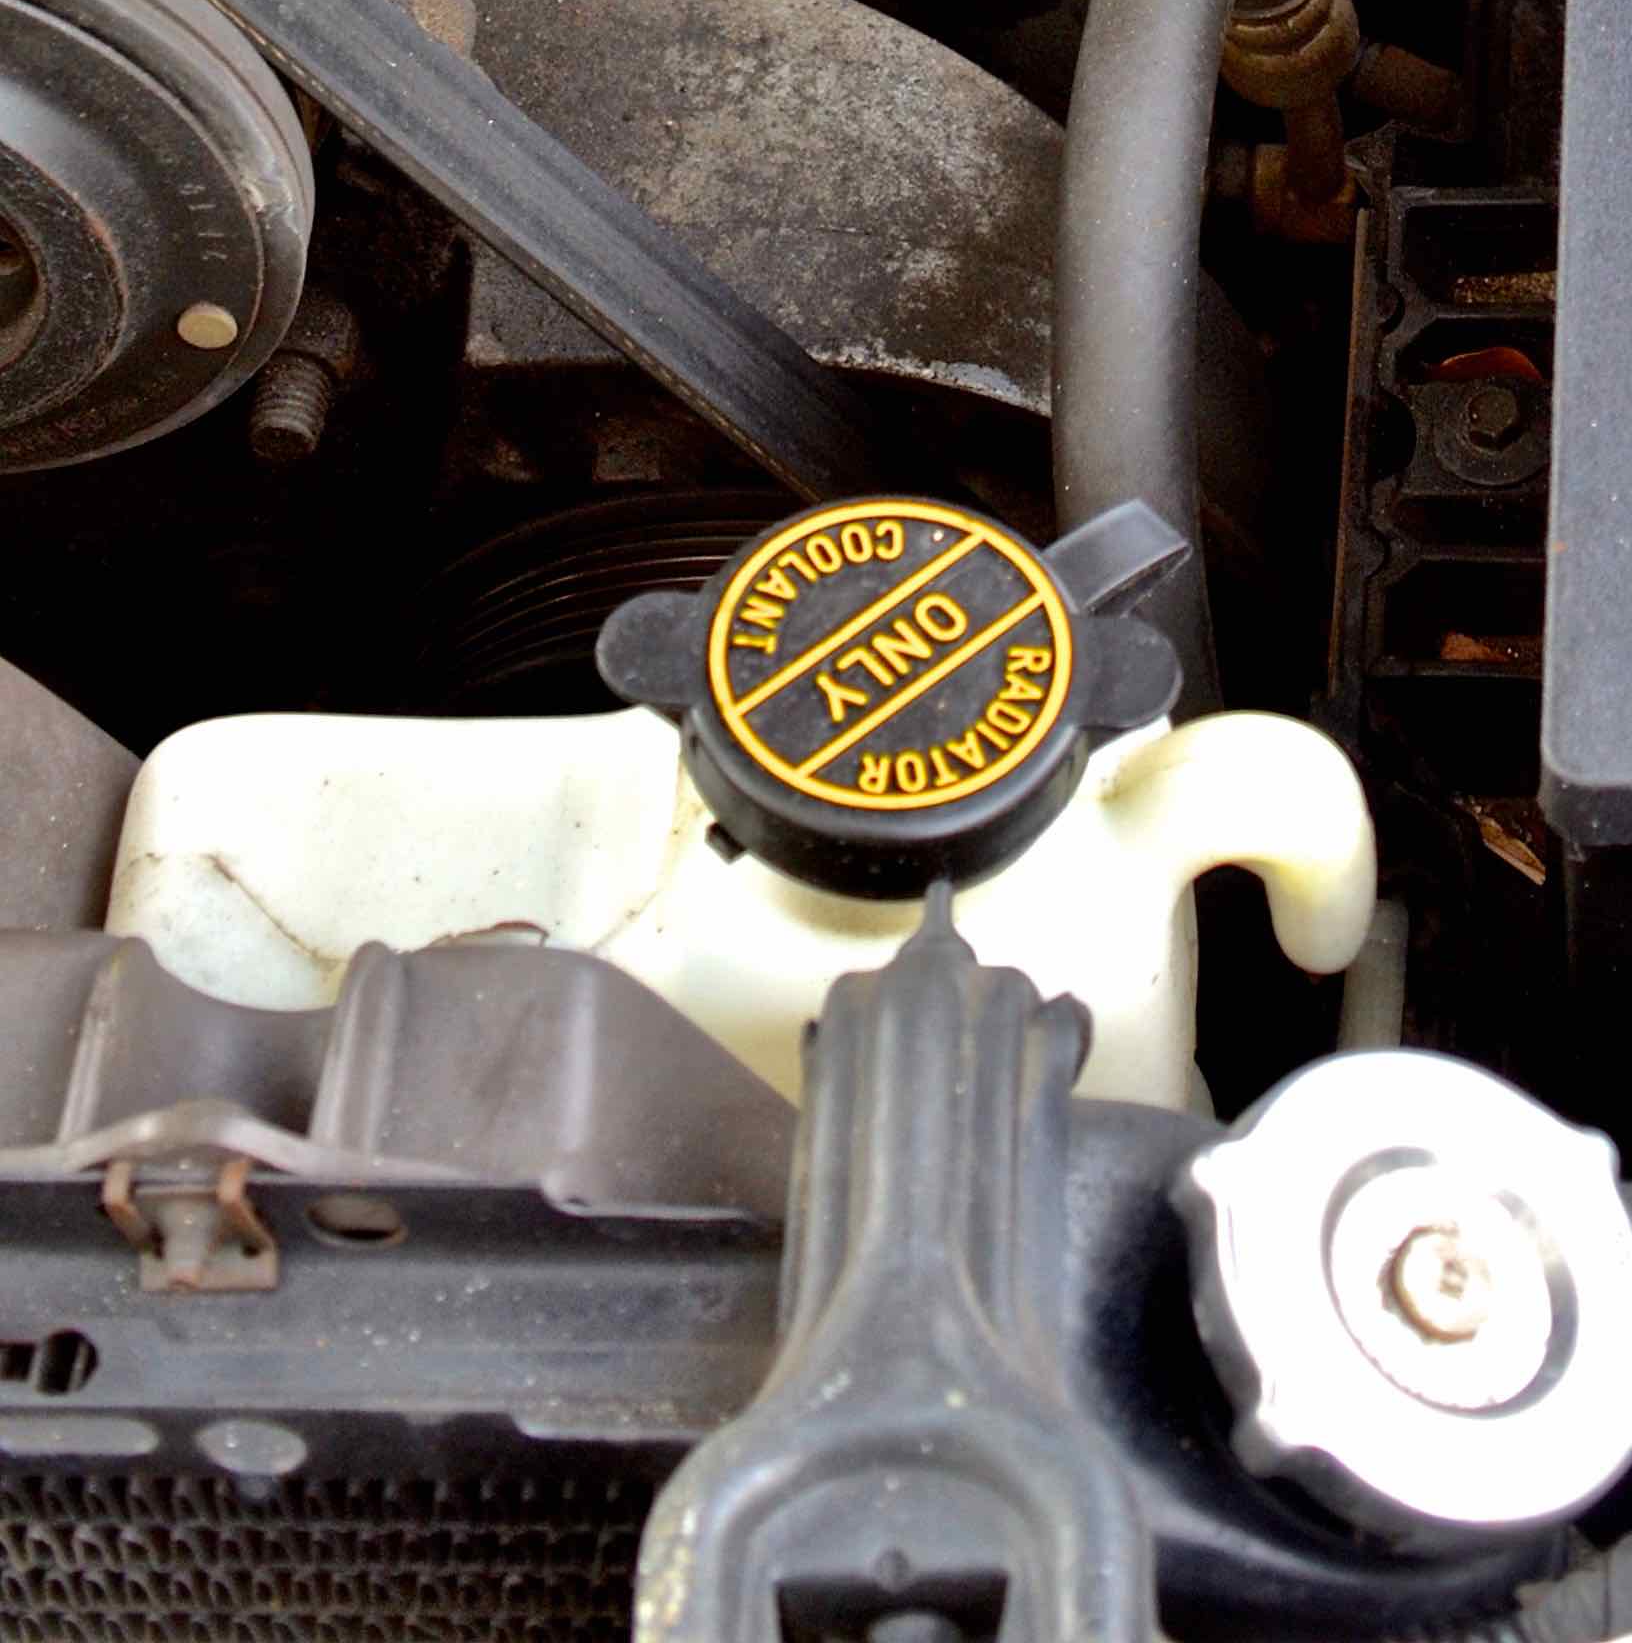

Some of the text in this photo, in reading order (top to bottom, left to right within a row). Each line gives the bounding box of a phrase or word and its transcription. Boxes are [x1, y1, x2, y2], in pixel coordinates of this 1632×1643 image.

[733, 518, 905, 655] COOLANT
[815, 591, 969, 723] ONLY
[857, 643, 1054, 795] RADIATOR
